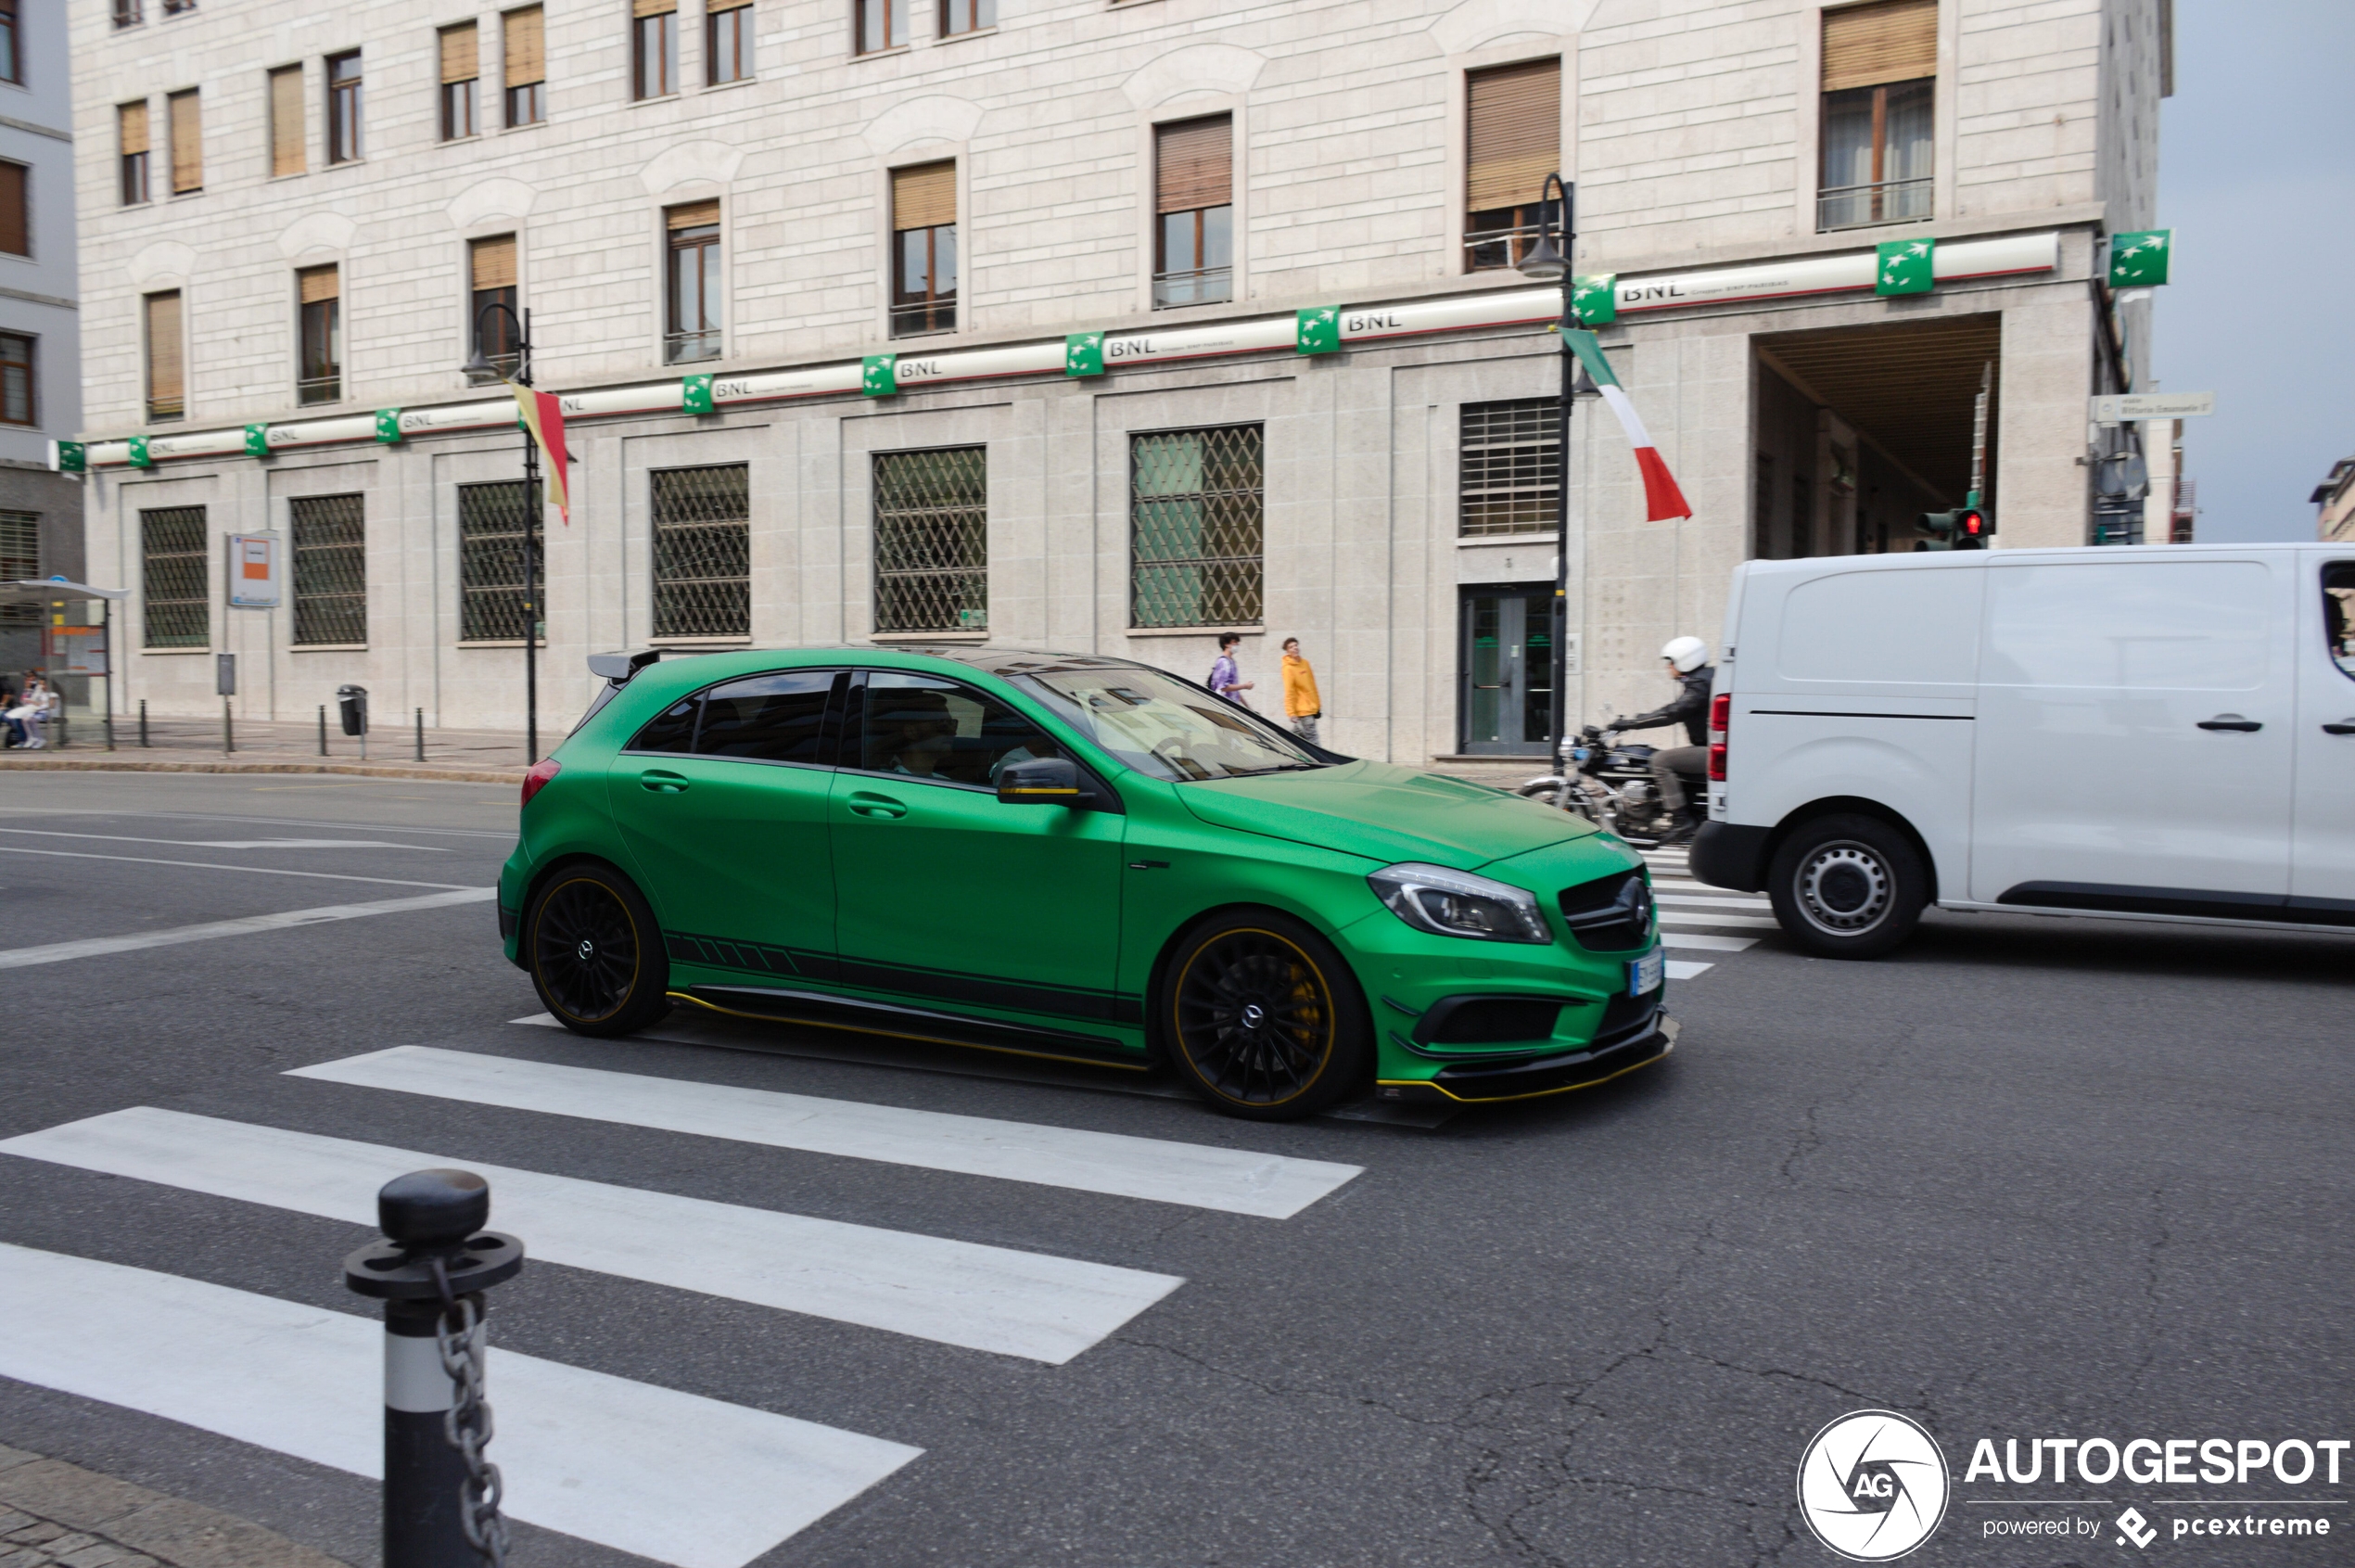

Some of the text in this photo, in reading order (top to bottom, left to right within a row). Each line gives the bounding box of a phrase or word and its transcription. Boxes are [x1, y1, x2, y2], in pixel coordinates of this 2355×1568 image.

[1624, 281, 1684, 301] BNL
[1349, 313, 1402, 332] BNL
[1111, 339, 1156, 357] BNL
[901, 361, 942, 377] BNL
[716, 382, 753, 397] BNL
[562, 399, 585, 412] NL
